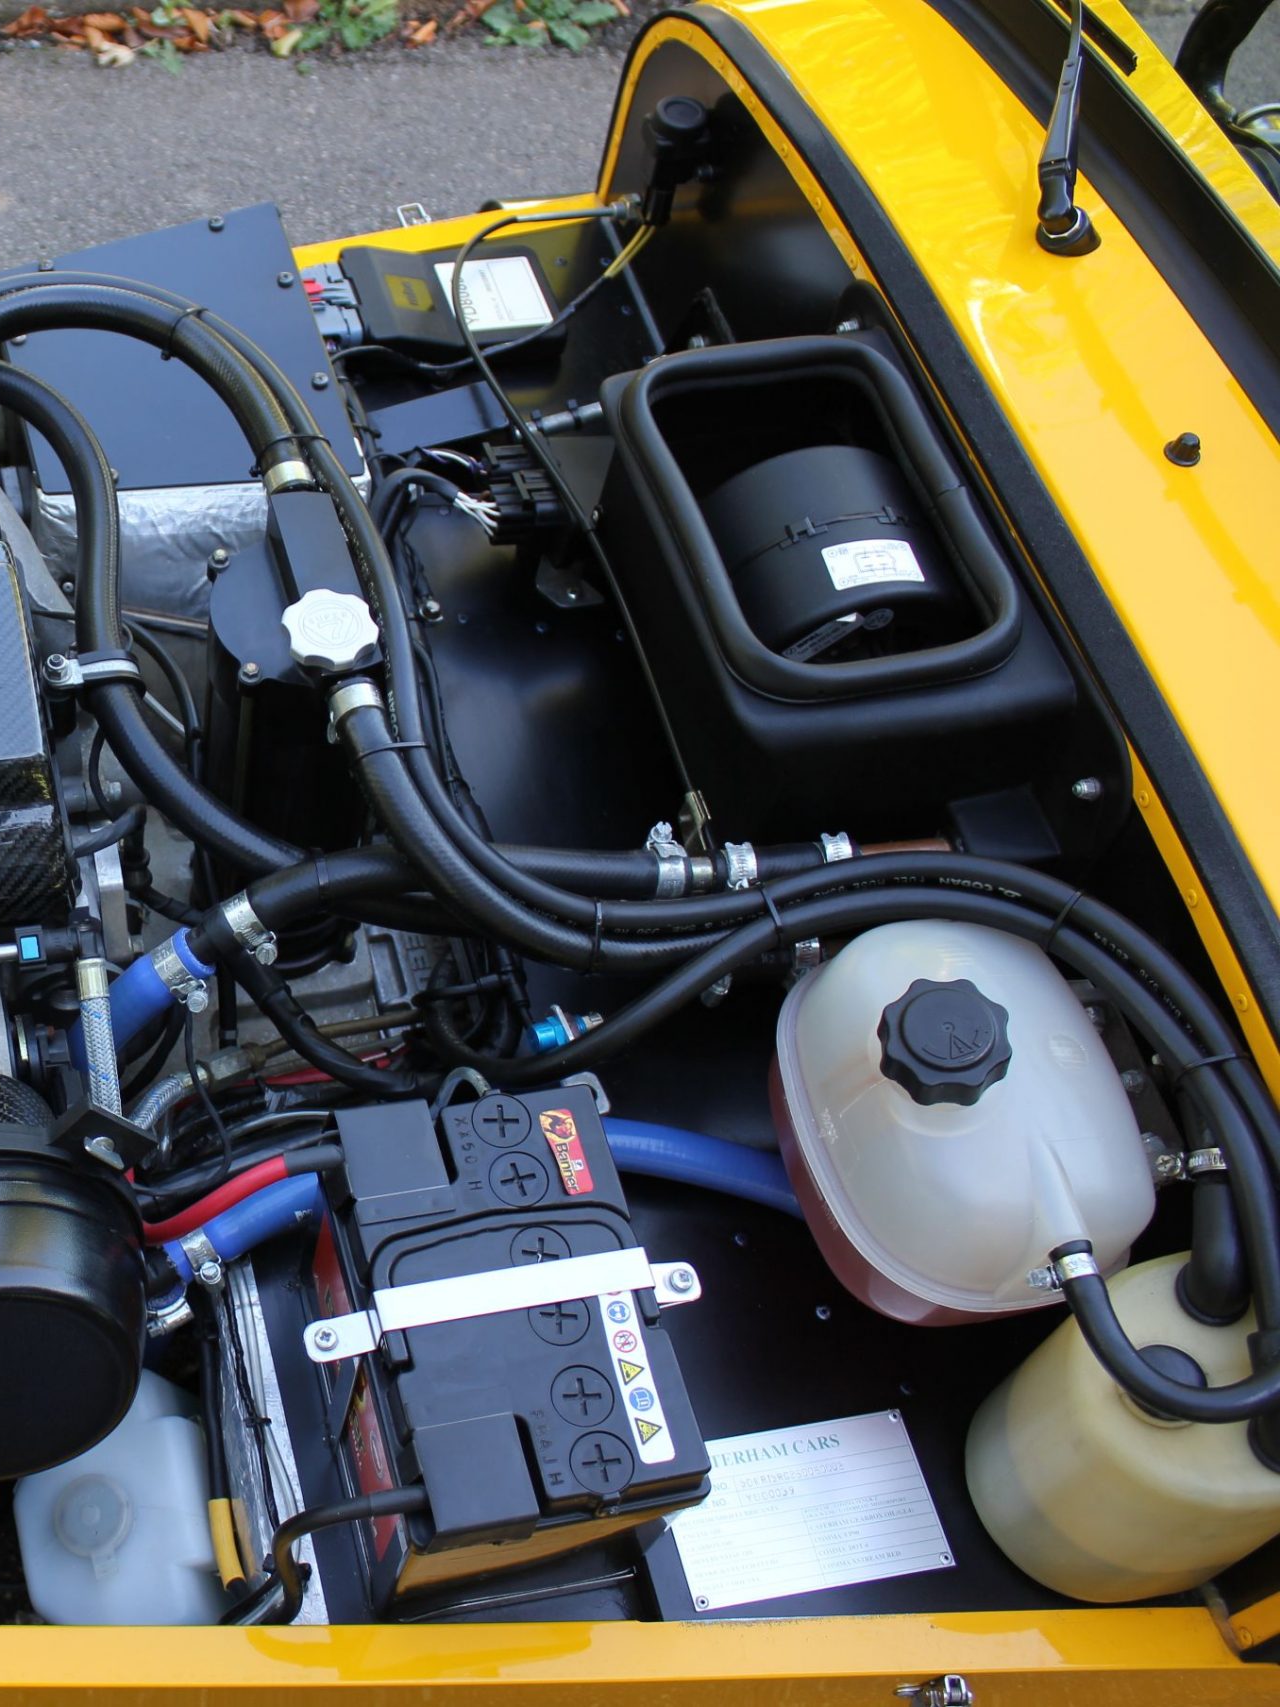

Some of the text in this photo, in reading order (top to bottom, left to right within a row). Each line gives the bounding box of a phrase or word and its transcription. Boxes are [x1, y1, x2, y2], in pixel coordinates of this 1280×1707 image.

[938, 876, 994, 893] CODAN
[555, 1143, 579, 1192] Banner
[711, 1433, 841, 1468] TERHAM CARS
